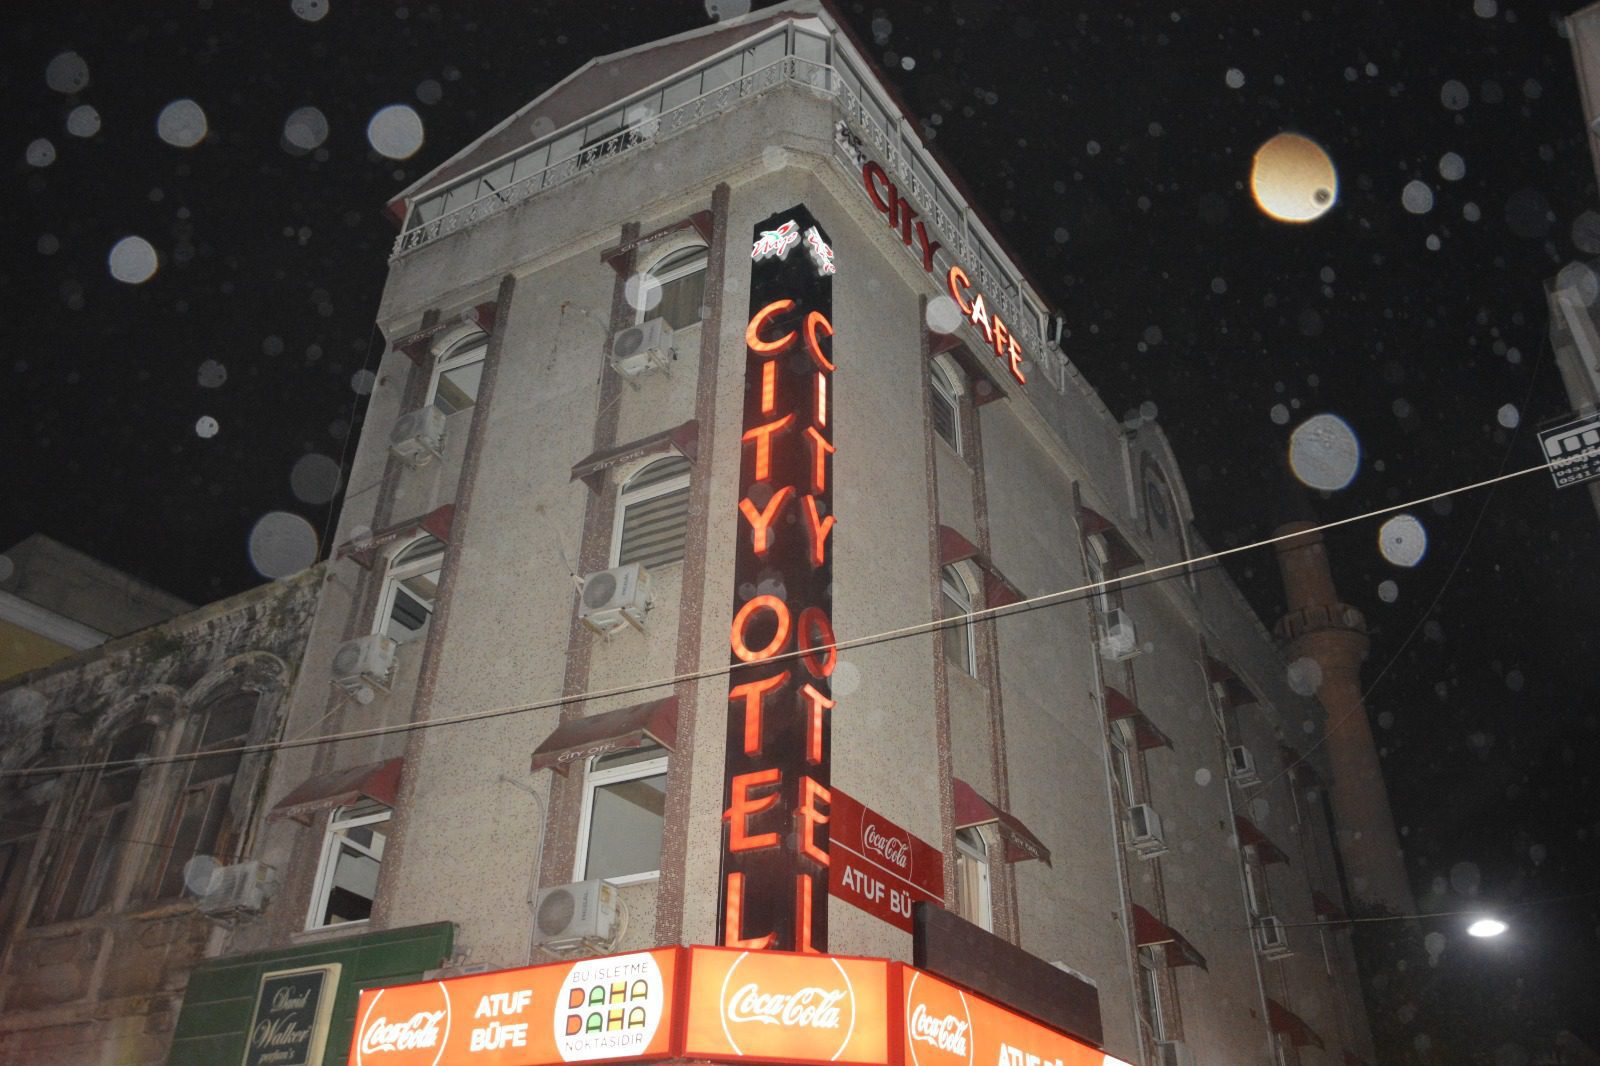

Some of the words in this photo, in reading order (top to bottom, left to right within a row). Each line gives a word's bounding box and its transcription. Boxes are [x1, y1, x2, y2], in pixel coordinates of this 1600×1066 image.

[863, 160, 942, 273] CITY
[948, 265, 1027, 386] CAFE
[738, 298, 799, 558] CITY
[801, 310, 838, 567] CITY
[723, 594, 792, 951] OTEL
[793, 606, 837, 953] OTEL
[842, 865, 885, 903] ATUF
[568, 978, 649, 1010] DAHA
[573, 971, 590, 983] BU
[475, 990, 532, 1018] ATUF
[565, 1005, 646, 1037] DAHA
[728, 984, 846, 1029] Coca-Cola
[362, 1010, 447, 1055] Coca-Cola
[470, 1023, 528, 1051] BÜFE
[565, 1032, 644, 1053] NOKTASIDIR
[910, 1003, 968, 1056] Coca-Cola
